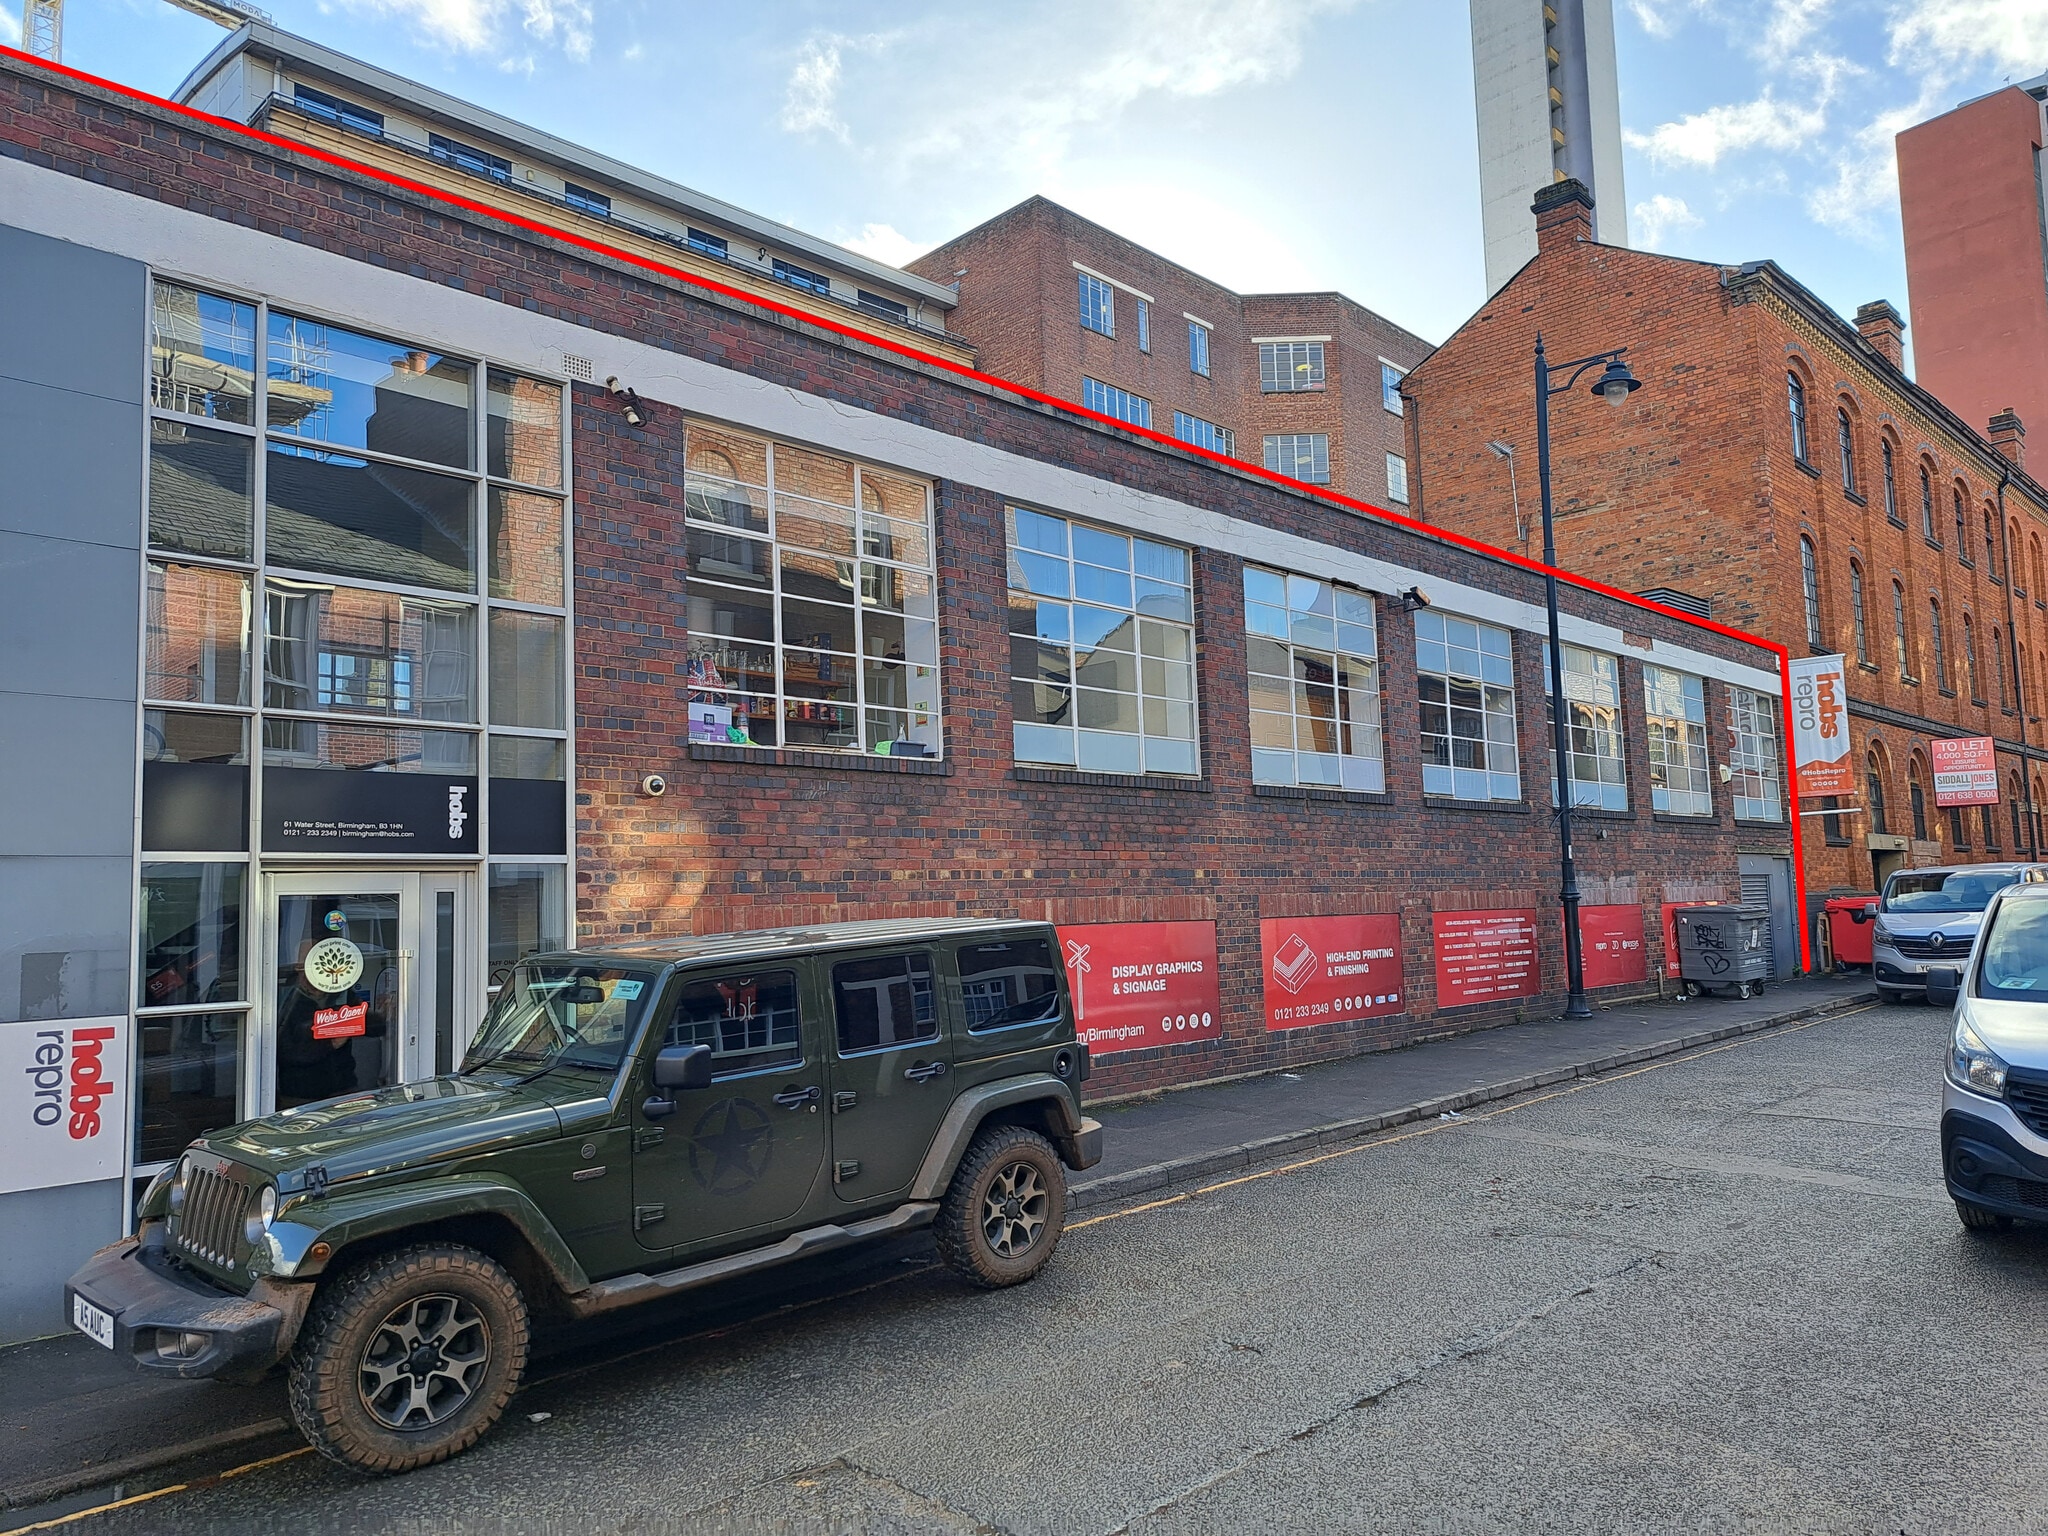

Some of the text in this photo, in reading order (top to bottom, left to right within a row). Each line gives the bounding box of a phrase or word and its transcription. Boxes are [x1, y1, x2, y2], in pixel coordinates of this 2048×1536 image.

[233, 1, 260, 17] MODA
[1793, 675, 1815, 731] repro
[1816, 672, 1843, 739] hobs
[1939, 740, 1986, 752] TO LET
[1936, 752, 1960, 760] 4,000
[1801, 768, 1846, 776] @HobsRepro
[1943, 763, 1986, 771] OPPORTUNITY
[1937, 774, 1970, 785] SIDDALL
[1970, 773, 1995, 789] JONES
[1938, 790, 1997, 800] 0121 638 0500
[448, 785, 468, 839] hobs
[338, 822, 378, 830] Birmingham,
[342, 830, 415, 838] birmingham@hobs.com
[1326, 947, 1394, 963] HIGH-END PRINTING
[1112, 961, 1203, 979] DISPLAY GRAPHICS
[1327, 963, 1369, 977] & FINISHING
[1113, 979, 1166, 995] & SIGNAGE
[340, 1005, 366, 1020] Open!
[1274, 1003, 1329, 1020] 0121 233 2349
[25, 1030, 64, 1126] repro
[69, 1027, 116, 1140] hobs
[80, 1302, 105, 1339] A5 AUC
